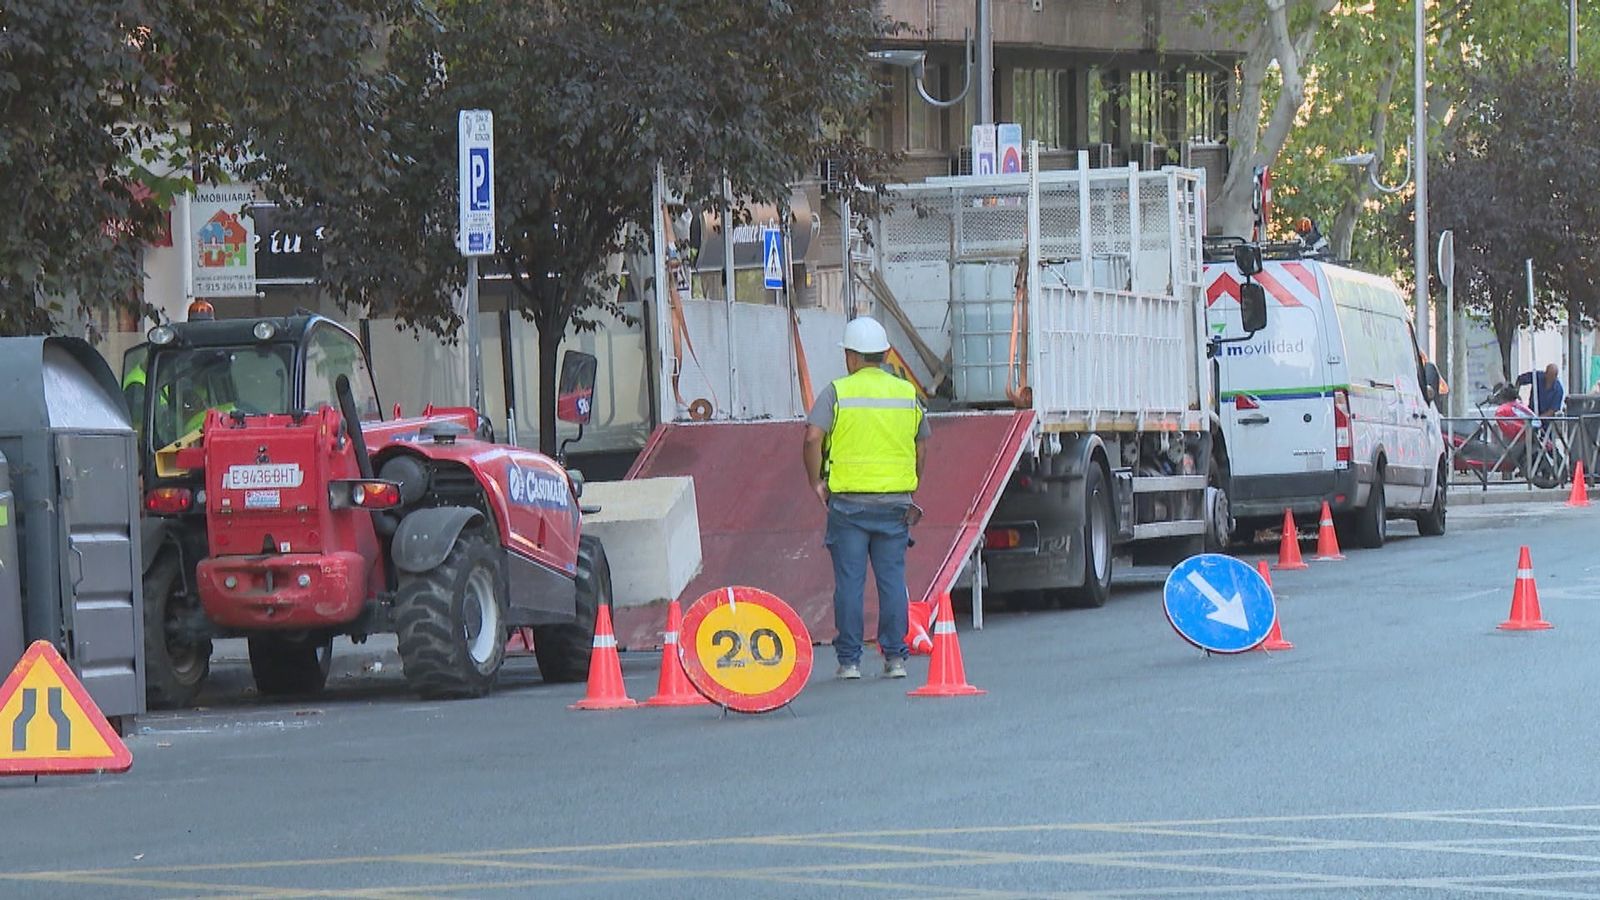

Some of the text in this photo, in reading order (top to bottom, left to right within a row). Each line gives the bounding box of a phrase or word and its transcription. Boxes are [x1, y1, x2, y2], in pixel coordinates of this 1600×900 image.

[471, 154, 486, 204] P
[190, 191, 252, 203] INMOBILIARIA
[1226, 339, 1305, 356] movilidad
[711, 627, 784, 669] 20
